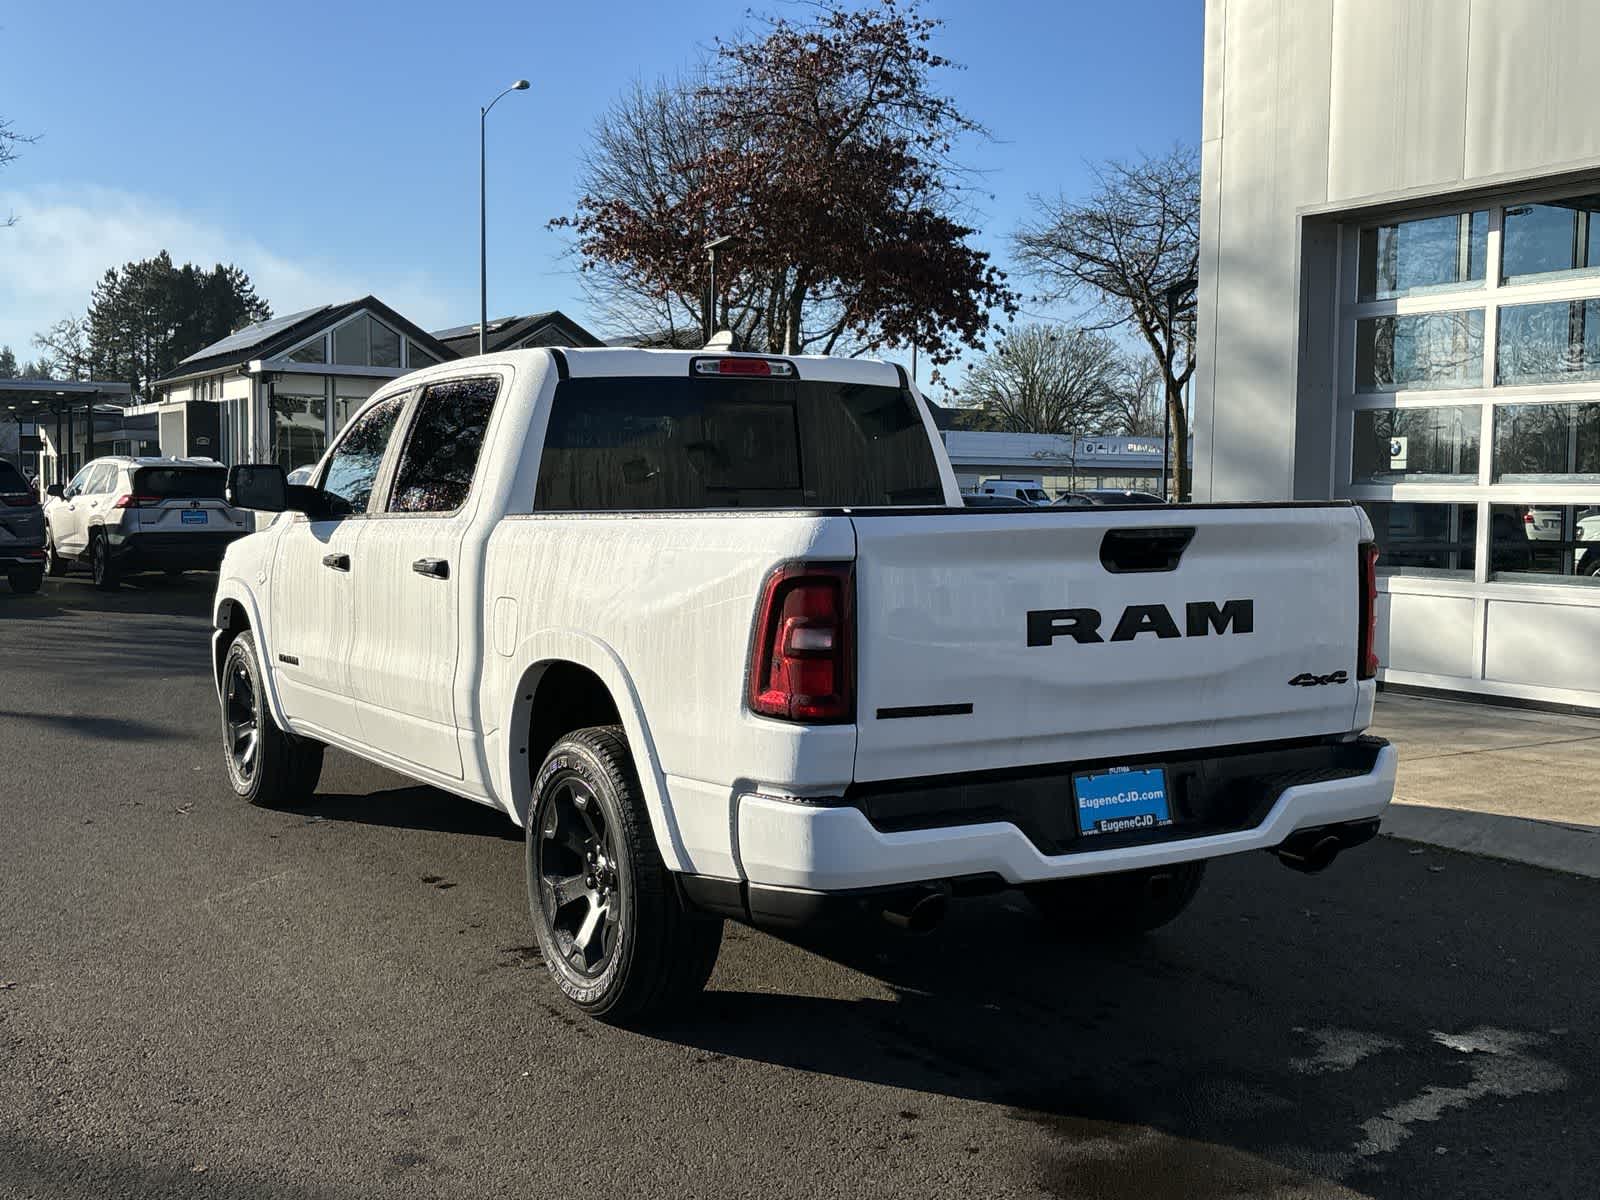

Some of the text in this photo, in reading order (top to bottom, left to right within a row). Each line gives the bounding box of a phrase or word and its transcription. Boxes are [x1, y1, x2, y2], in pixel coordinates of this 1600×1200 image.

[1027, 599, 1254, 647] RAM
[1288, 670, 1349, 687] 4x4
[1079, 790, 1164, 809] EugeneCJD.com
[1100, 815, 1153, 832] EugeneCJD
